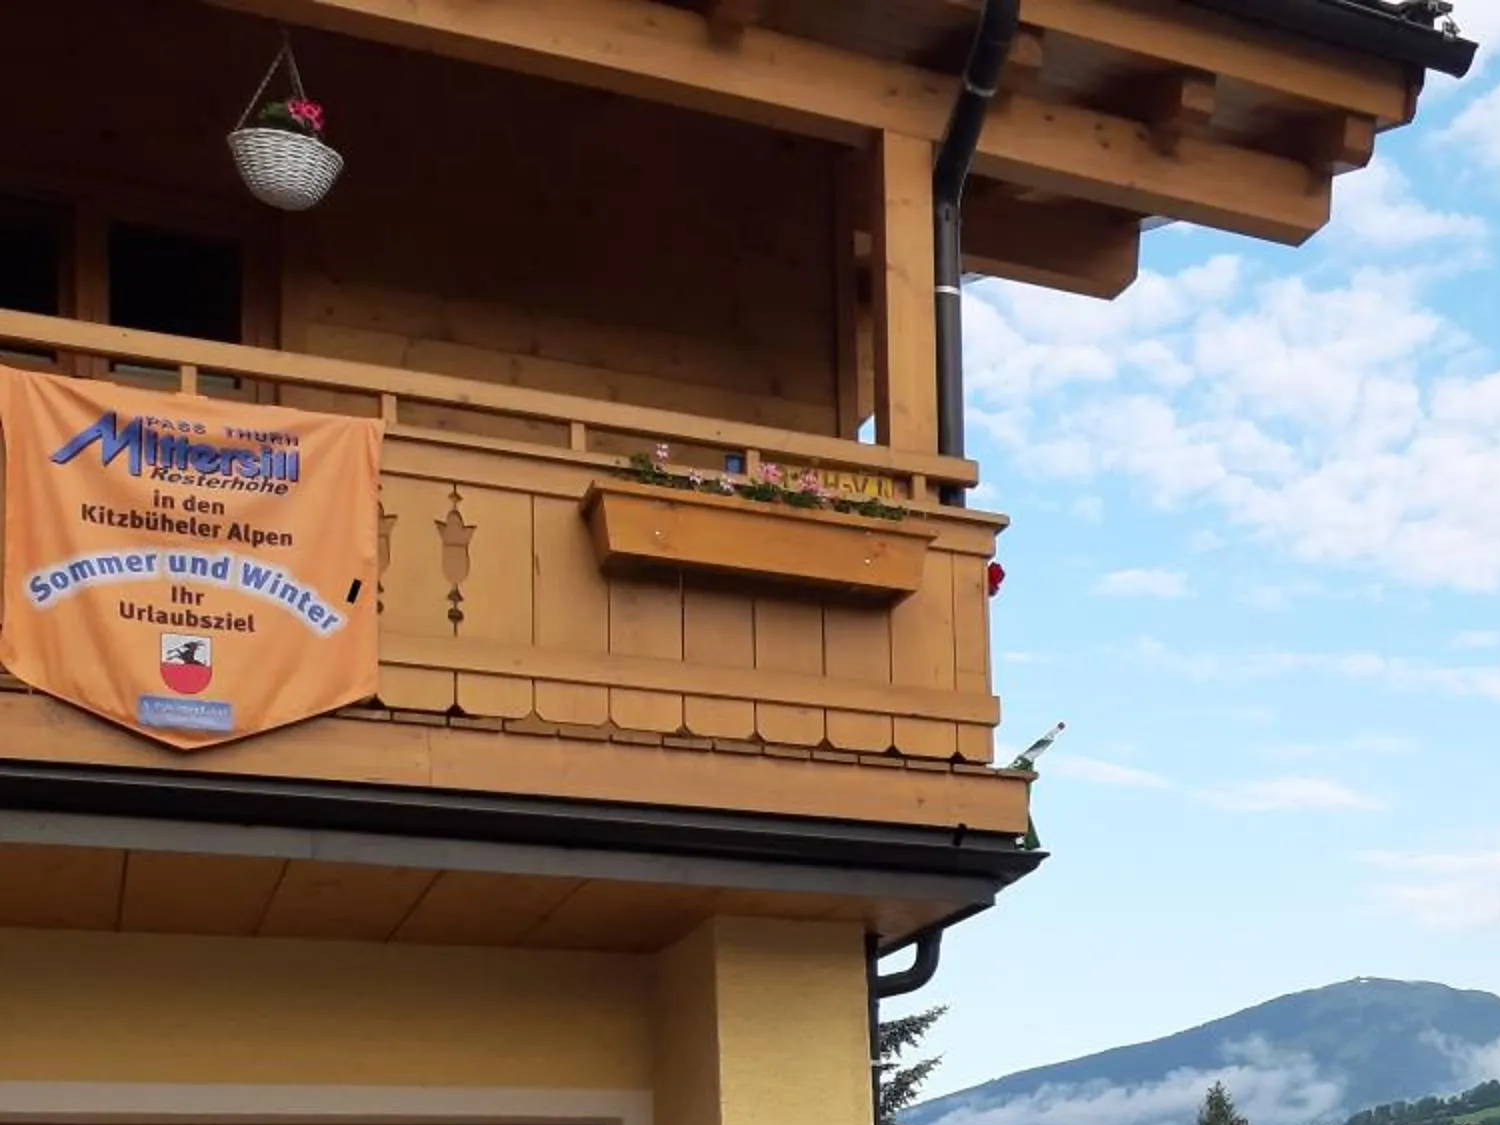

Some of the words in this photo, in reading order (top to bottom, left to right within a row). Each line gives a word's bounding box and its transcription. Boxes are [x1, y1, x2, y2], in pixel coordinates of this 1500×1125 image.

[146, 416, 207, 435] PASS
[51, 410, 300, 482] Mittersill
[153, 490, 174, 508] in
[183, 493, 225, 515] den
[81, 504, 222, 539] Kitzbüheler
[227, 523, 293, 548] Alpen
[29, 552, 157, 603] Sommer
[169, 554, 230, 581] und
[242, 562, 339, 630] Winter
[171, 586, 204, 606] Ihr
[119, 601, 256, 632] Urlaubsziel
